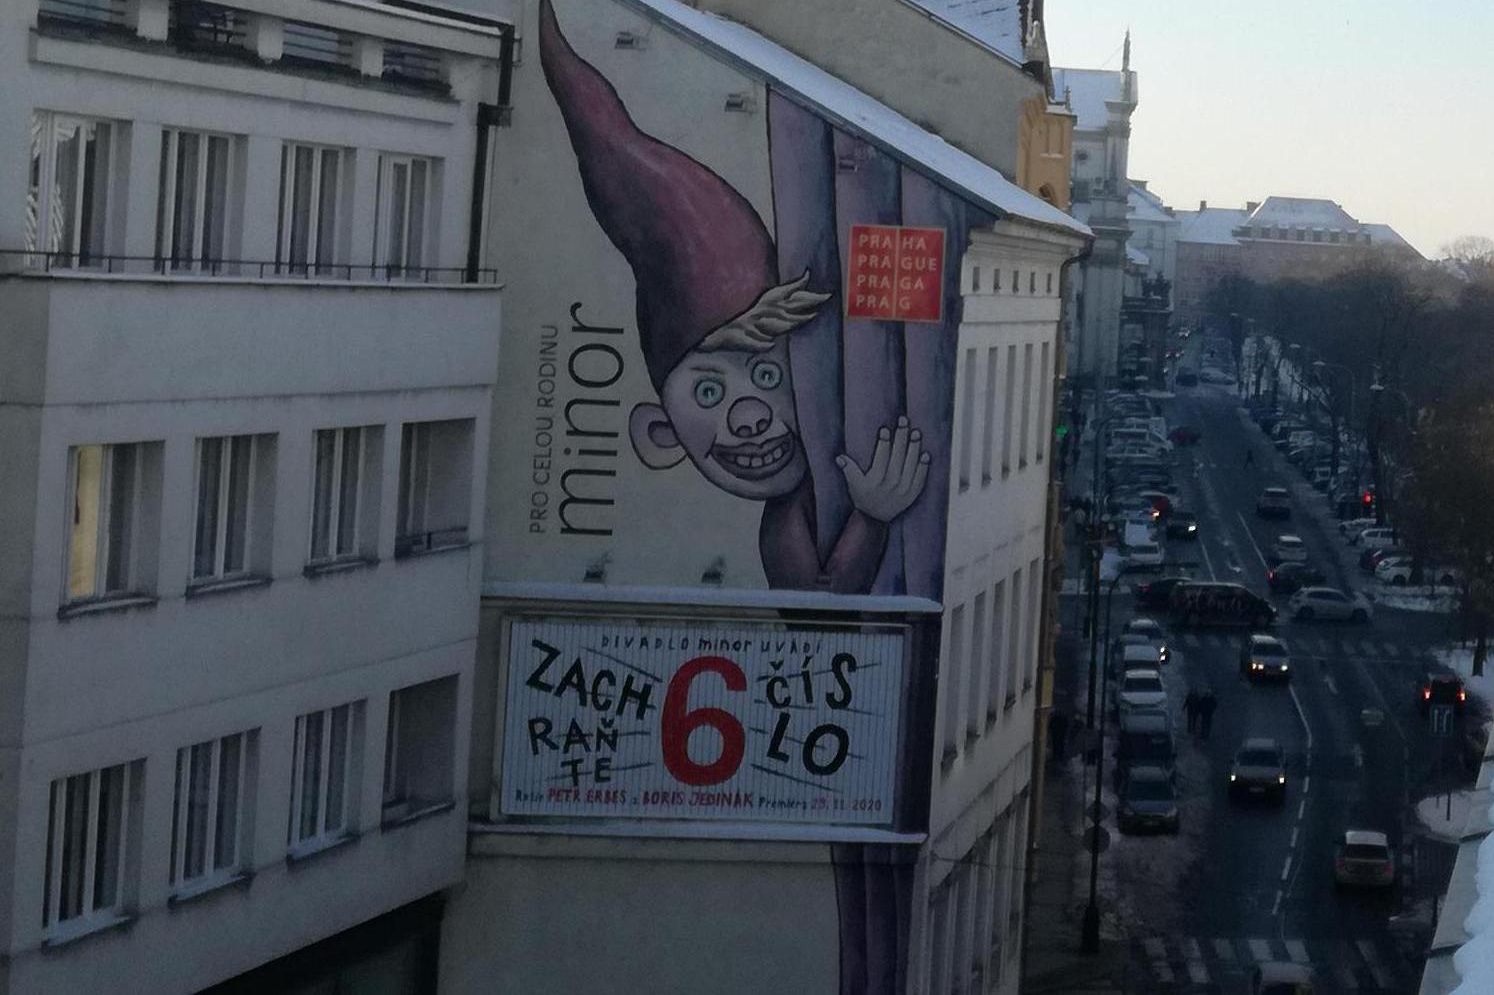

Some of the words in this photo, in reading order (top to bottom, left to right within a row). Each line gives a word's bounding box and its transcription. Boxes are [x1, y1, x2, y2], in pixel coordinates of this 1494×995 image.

[859, 234, 892, 249] PRA
[902, 237, 927, 250] HA
[857, 274, 890, 289] PRA
[900, 276, 924, 290] GA
[858, 254, 891, 269] PRA
[901, 256, 937, 271] GUE
[856, 294, 889, 309] PRA
[899, 297, 910, 310] G
[538, 325, 558, 407] RODINU
[558, 301, 624, 536] minor
[534, 417, 554, 484] CELOU
[530, 491, 549, 534] PRO
[602, 635, 689, 651] DIVADLO
[526, 639, 653, 720] ZACH
[765, 652, 856, 710] ČÍS
[527, 717, 618, 755] RAŇ
[661, 656, 747, 785] 6
[766, 712, 849, 776] LO
[561, 758, 612, 786] TE
[643, 791, 684, 805] BORIS
